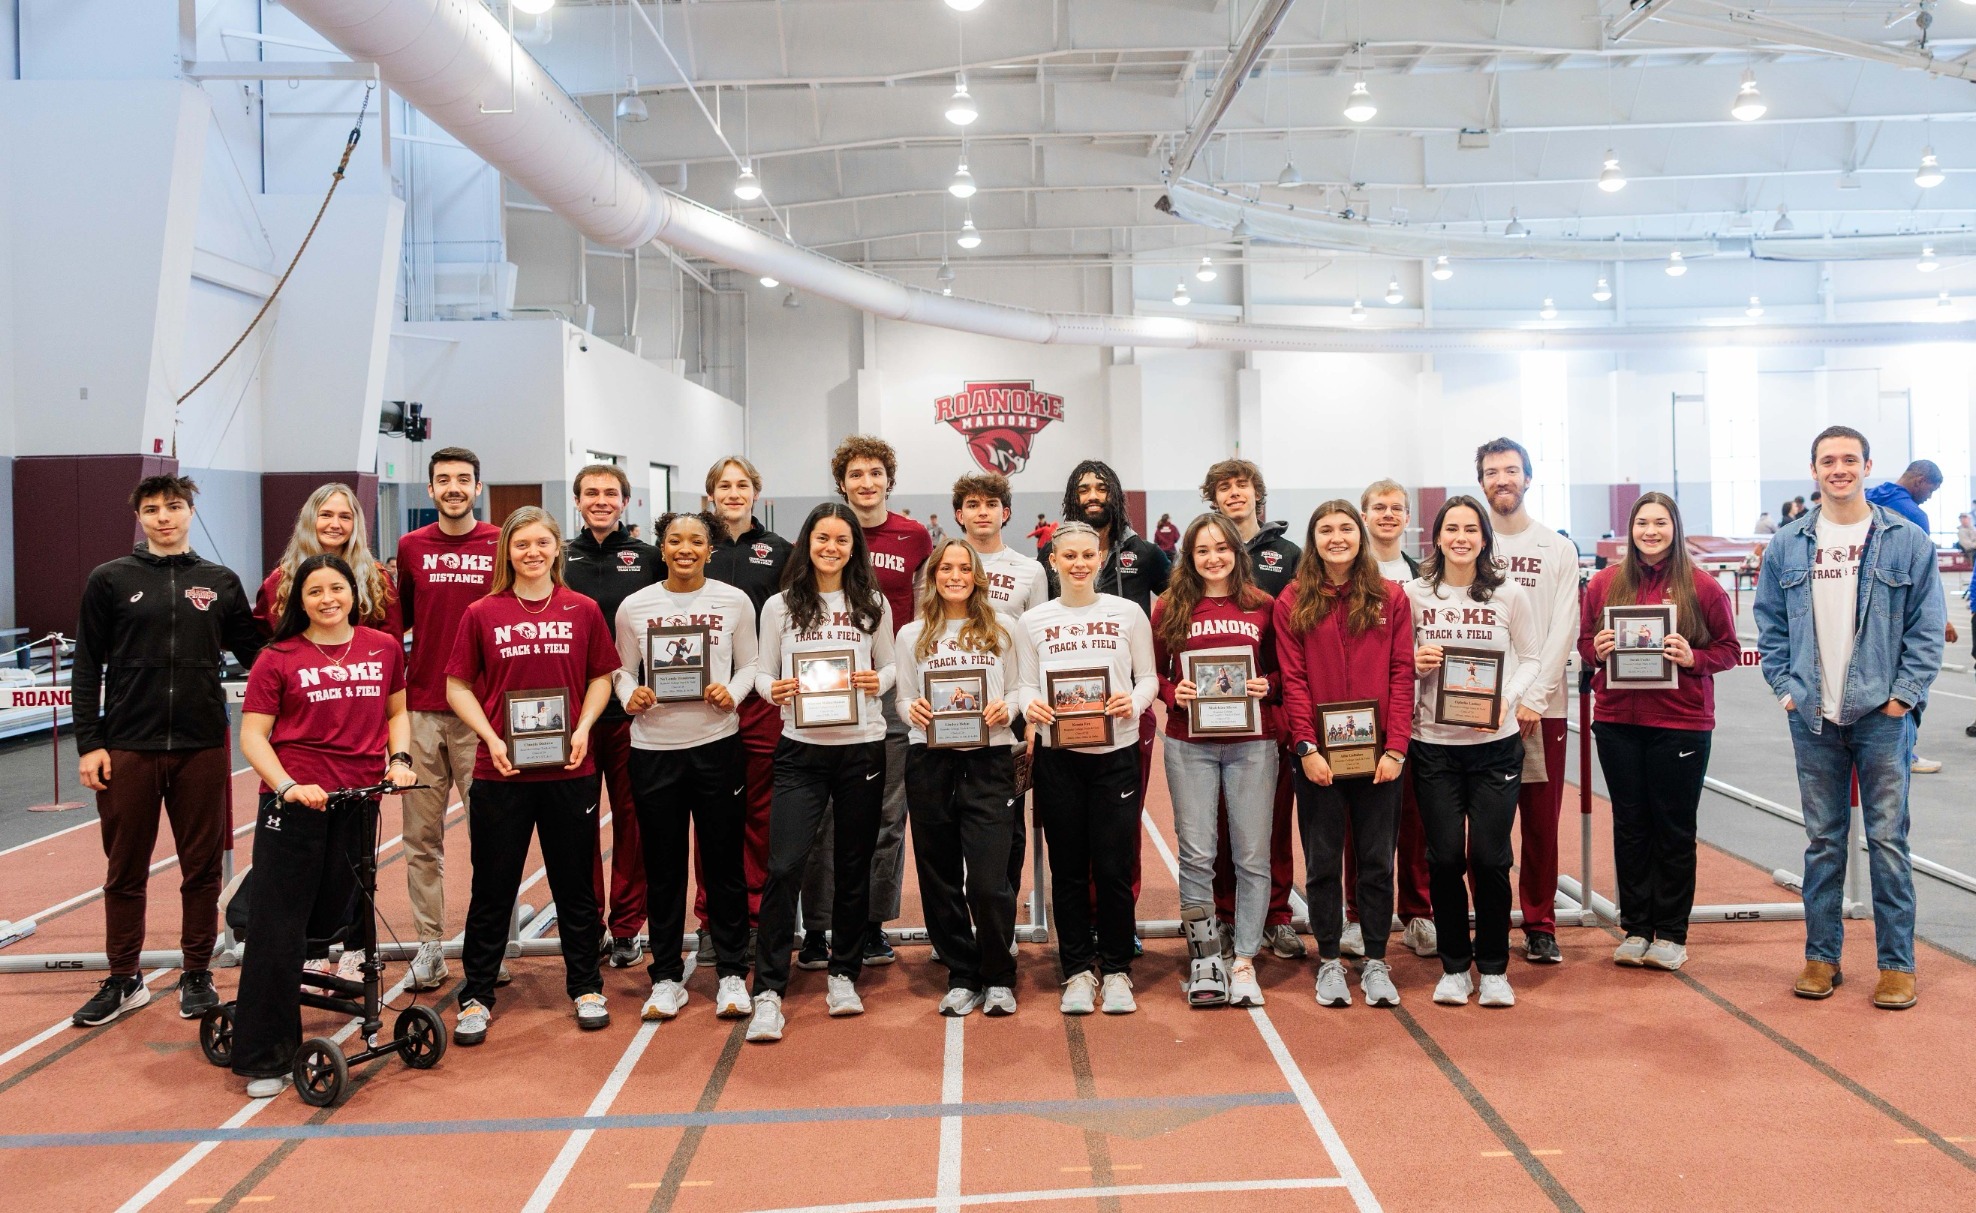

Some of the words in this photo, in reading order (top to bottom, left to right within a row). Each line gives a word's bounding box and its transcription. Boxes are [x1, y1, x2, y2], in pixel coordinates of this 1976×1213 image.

[934, 388, 1064, 424] ROANOKE
[961, 414, 1038, 430] MAROONS
[429, 573, 484, 585] DISTANCE
[1812, 569, 1842, 580] TRACK
[795, 631, 823, 643] TRACK
[827, 630, 833, 639] &
[837, 631, 861, 643] FIELD
[1186, 619, 1260, 642] OANOKE
[1425, 629, 1452, 640] TRACK
[1456, 629, 1463, 639] &
[1466, 629, 1492, 641] FIELD
[500, 645, 530, 659] TRACK
[533, 643, 541, 654] &
[544, 643, 570, 654] FIELD
[1048, 641, 1077, 655] TRACK
[1081, 640, 1088, 650] &
[1091, 639, 1117, 650] FIELD
[927, 656, 957, 669] TRACK
[961, 655, 967, 665] &
[971, 655, 995, 666] FIELD
[12, 690, 73, 707] ROANO
[306, 687, 343, 703] TRACK
[345, 686, 354, 698] &
[355, 685, 381, 697] FIELD
[1724, 911, 1761, 920] UCS
[45, 960, 84, 969] UCS
